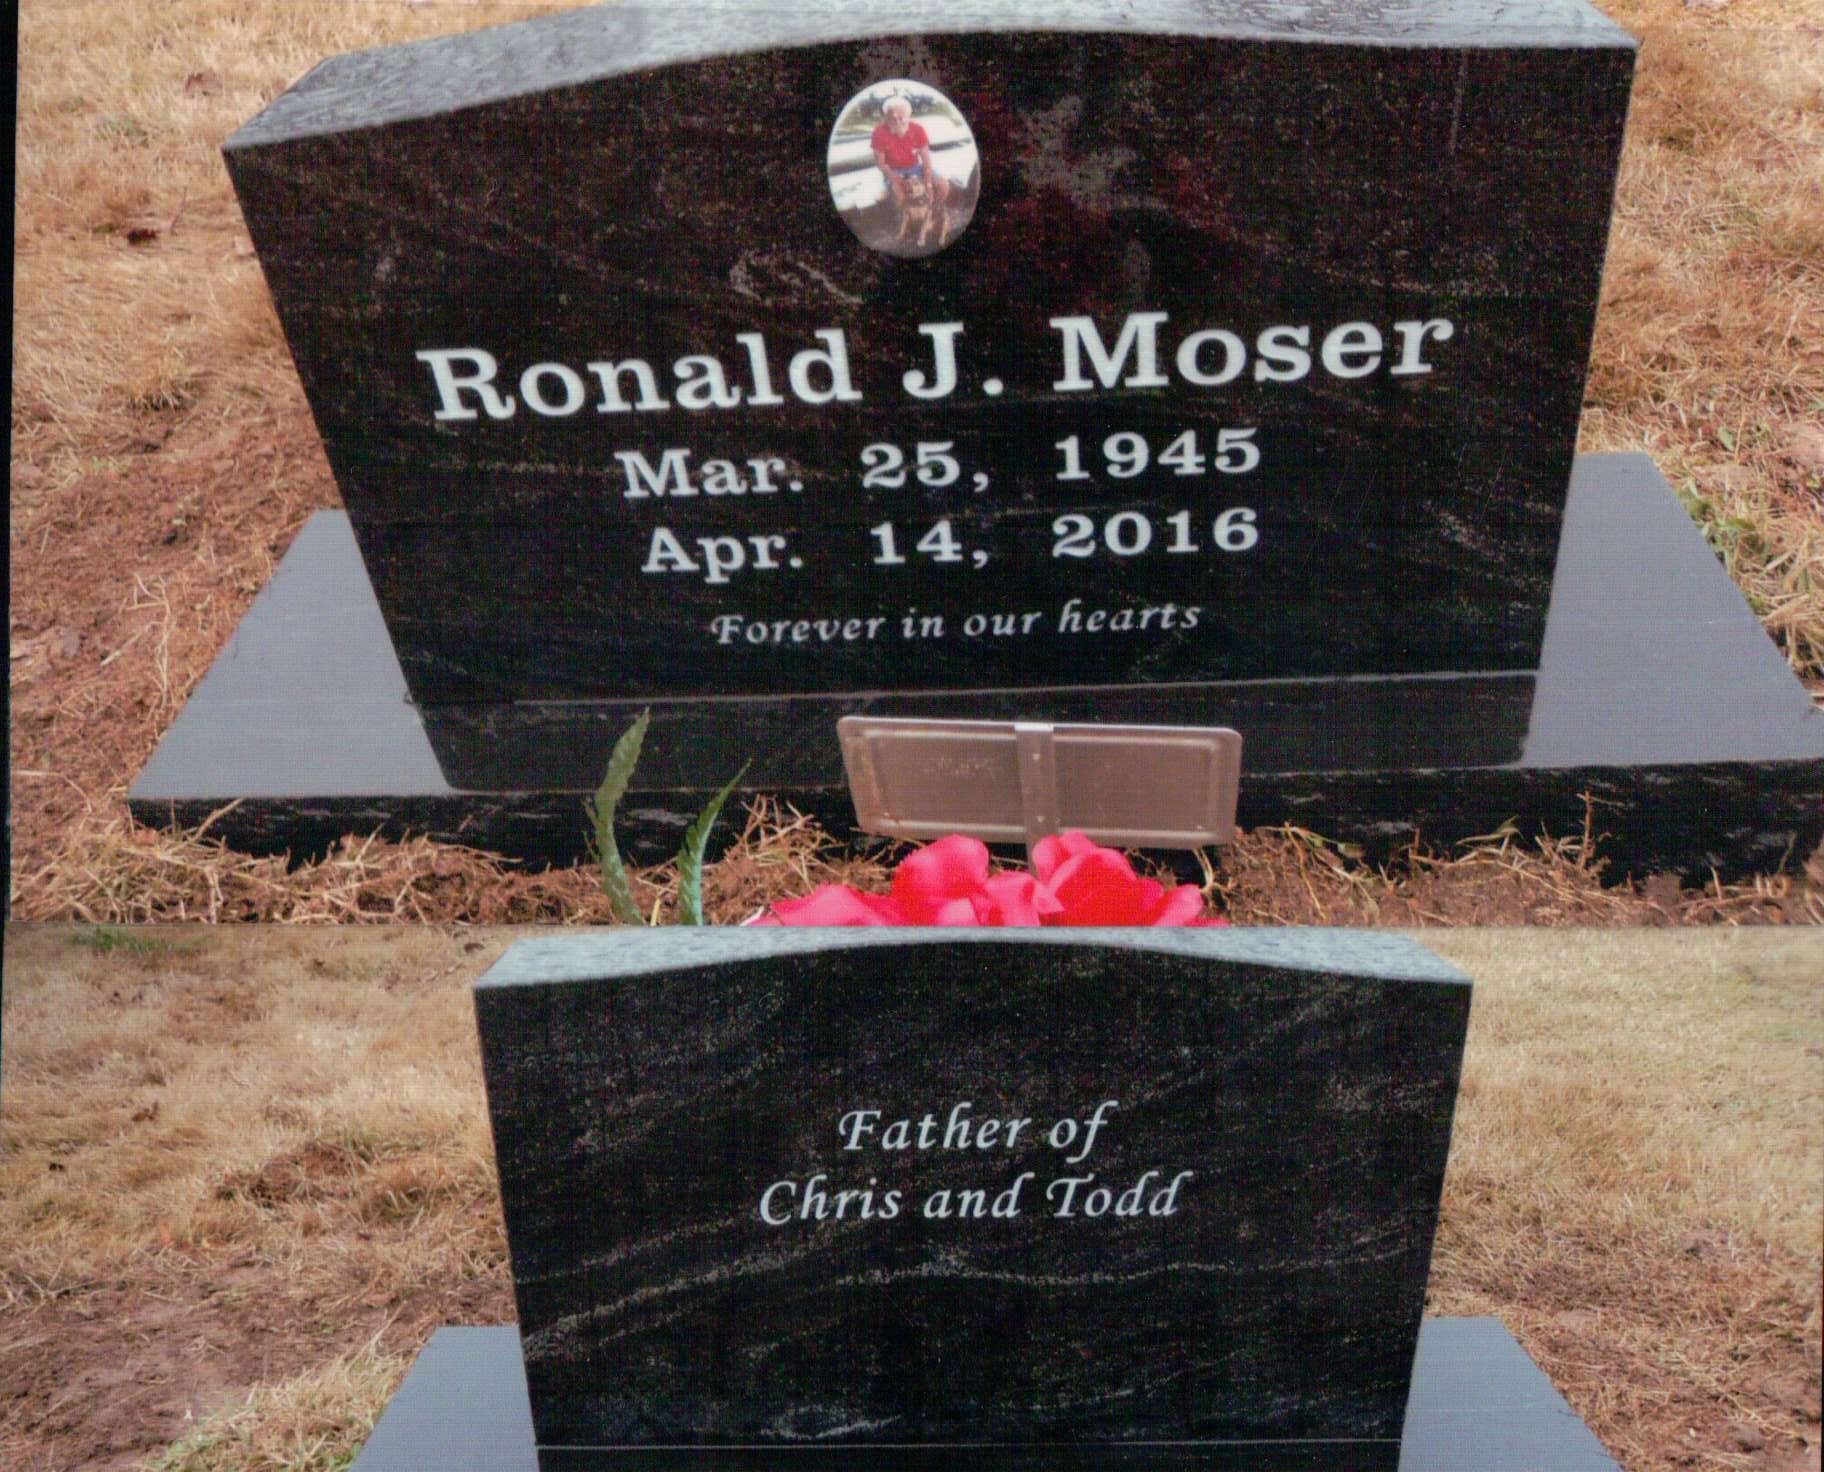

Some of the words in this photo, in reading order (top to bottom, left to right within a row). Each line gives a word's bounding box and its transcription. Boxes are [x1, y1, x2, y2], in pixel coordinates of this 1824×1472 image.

[415, 328, 864, 421] Ronald
[902, 322, 1004, 399] J.
[1049, 312, 1454, 391] Moser
[613, 448, 803, 499] Mar.
[860, 441, 989, 492] 25,
[1055, 428, 1261, 480] 1945
[641, 527, 803, 584] Apr.
[870, 519, 989, 568] 14,
[1052, 507, 1259, 558] 2016
[709, 614, 886, 645] Forever
[901, 607, 944, 639] in
[963, 611, 1042, 637] our
[1058, 598, 1202, 633] hearts
[837, 1100, 1033, 1151] Father
[1047, 1099, 1120, 1165] of
[759, 1173, 903, 1226] Chris
[922, 1170, 1034, 1219] and
[1045, 1169, 1195, 1218] Todd
